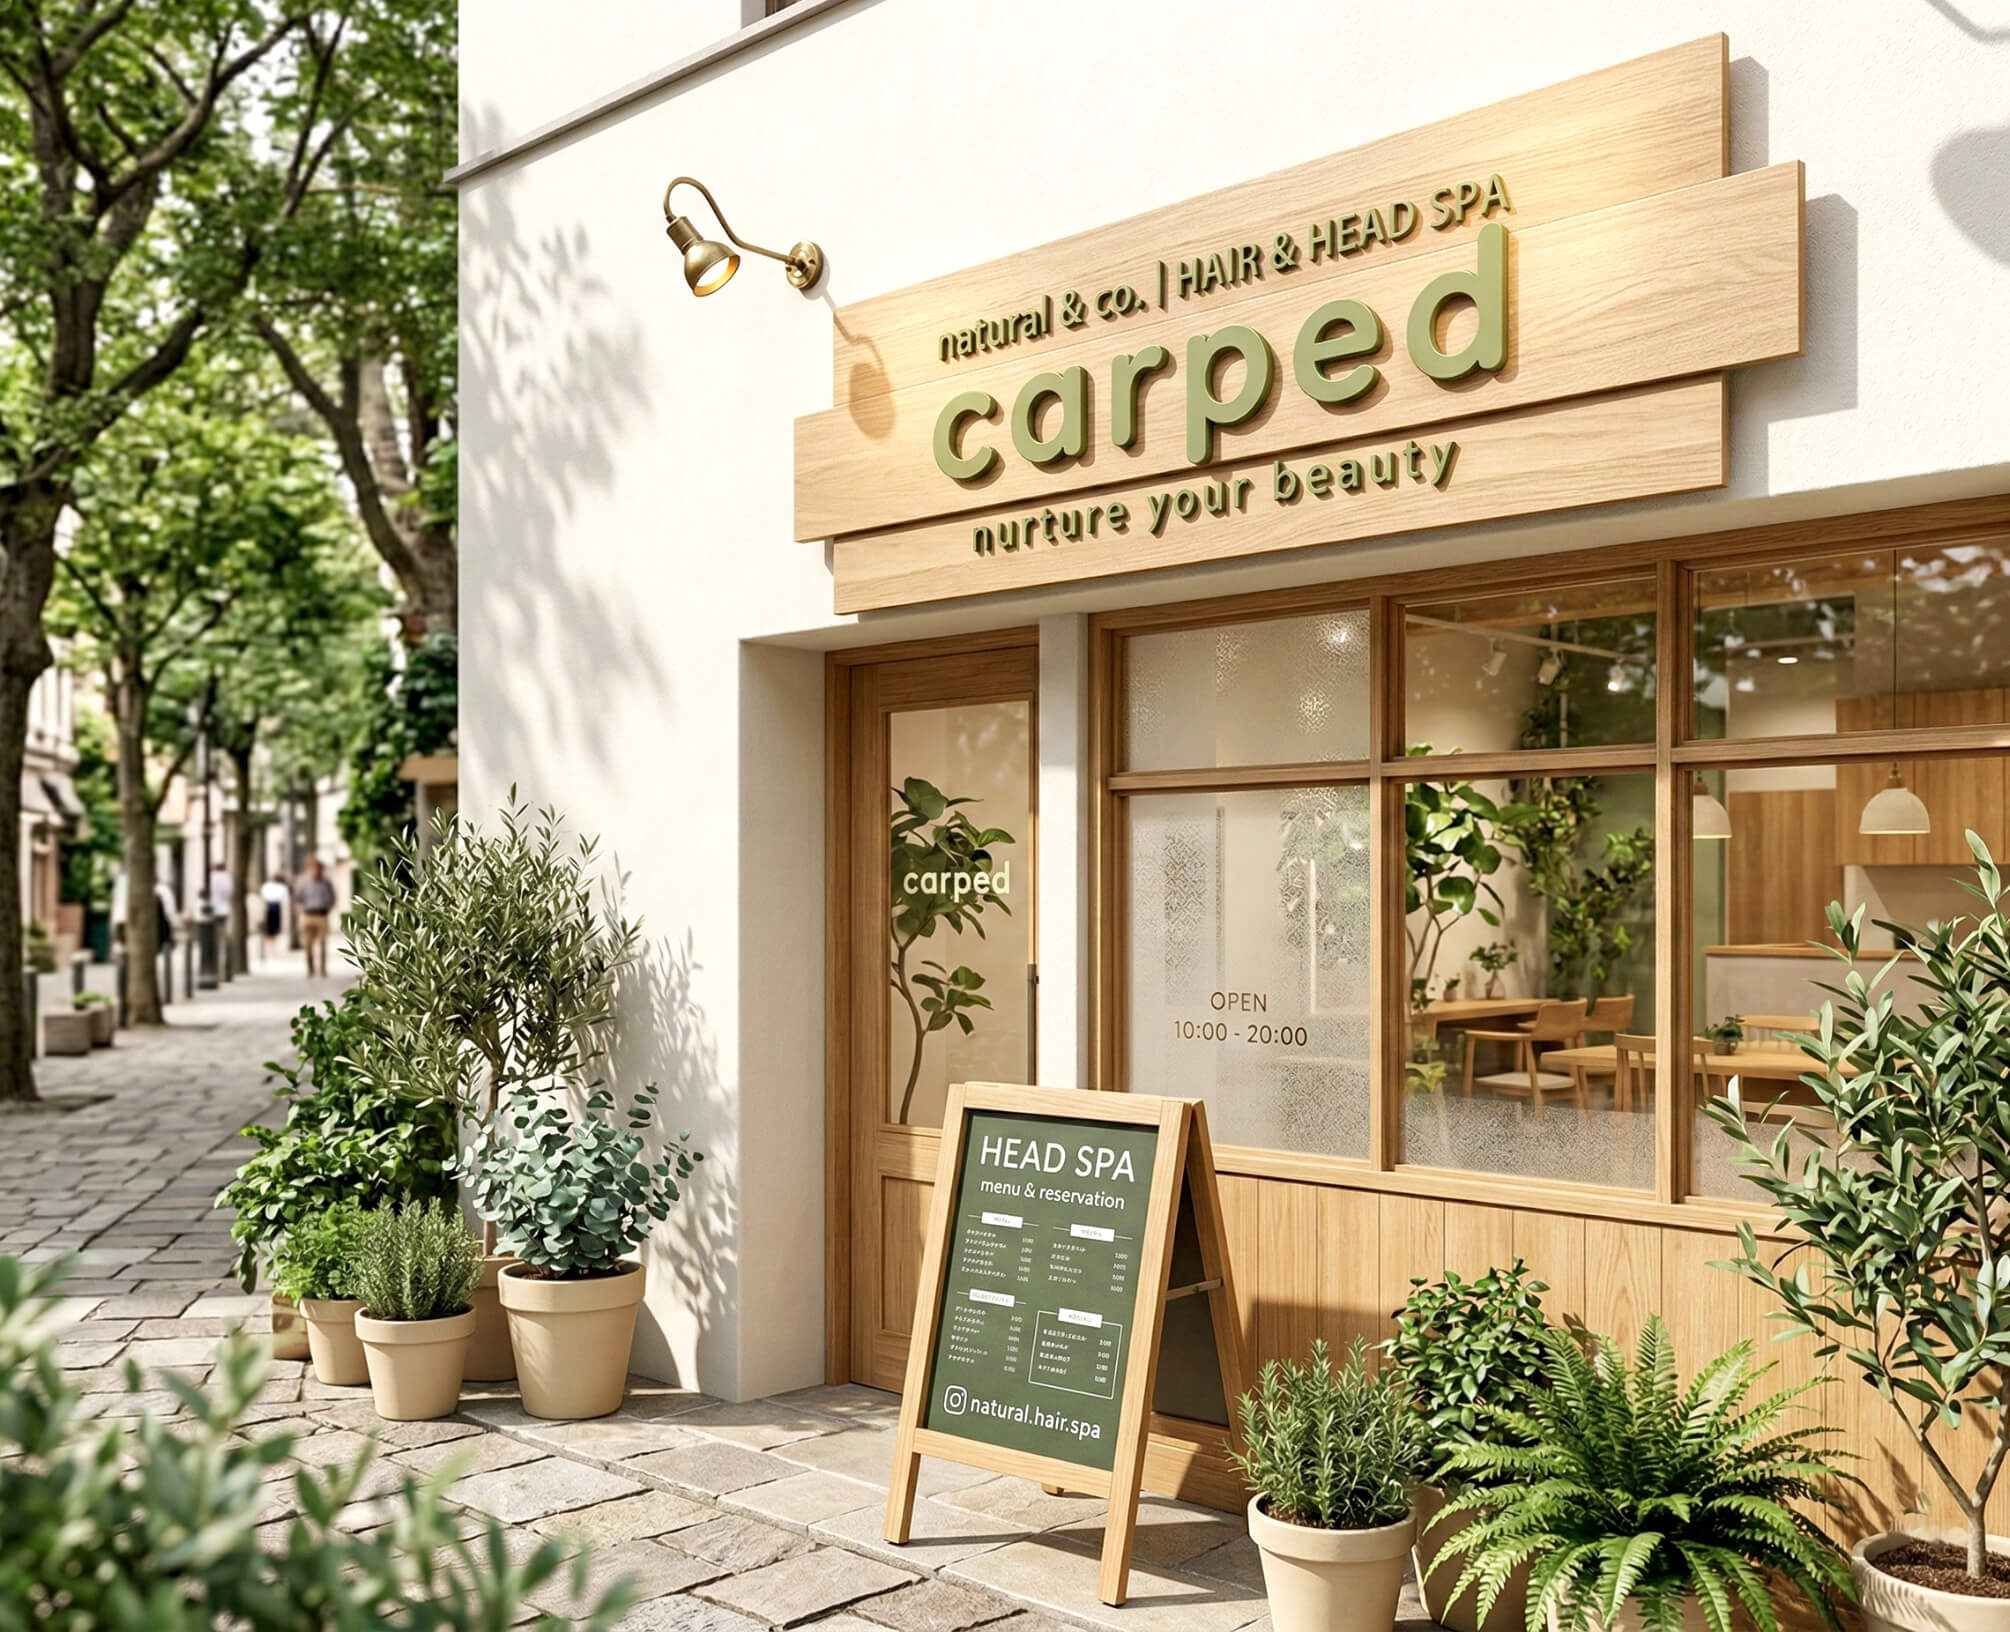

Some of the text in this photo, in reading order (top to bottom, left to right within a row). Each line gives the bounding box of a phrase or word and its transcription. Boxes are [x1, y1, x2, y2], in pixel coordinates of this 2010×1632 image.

[938, 295, 1051, 363] natural
[1061, 289, 1088, 327] &
[1094, 284, 1146, 319] co.
[1176, 242, 1261, 299] HAIR
[1271, 232, 1301, 273] &
[1308, 200, 1419, 263] HEAD
[1430, 173, 1512, 231] SPA
[932, 222, 1510, 466] carped
[972, 440, 1459, 555] nurture your beauty
[903, 860, 1010, 903] carped
[1210, 991, 1267, 1012] OPEN
[1175, 1020, 1227, 1041] 10:00
[1247, 1024, 1307, 1046] 20:00
[980, 1135, 1135, 1183] HEAD SPA
[980, 1180, 1125, 1210] menu & reservation
[970, 1396, 1102, 1441] natural.hair.spa
